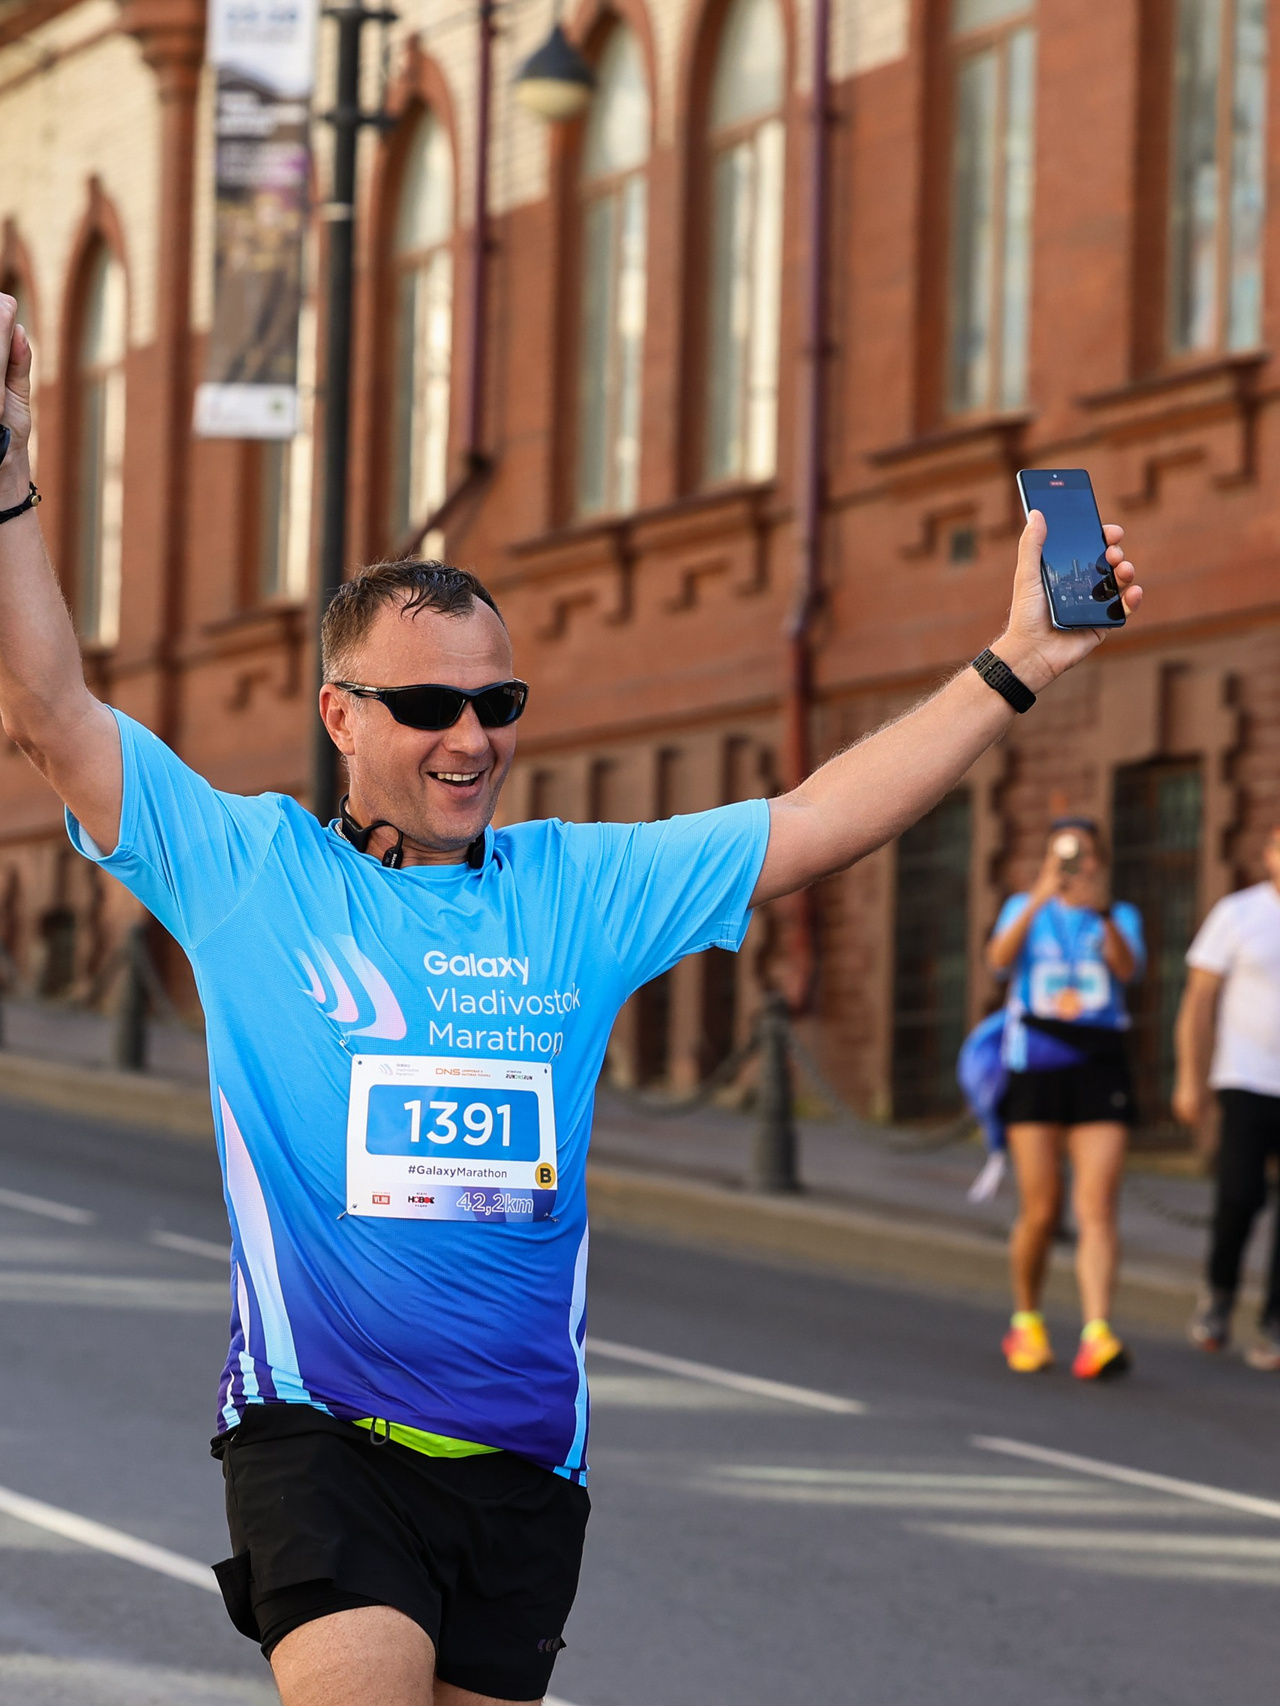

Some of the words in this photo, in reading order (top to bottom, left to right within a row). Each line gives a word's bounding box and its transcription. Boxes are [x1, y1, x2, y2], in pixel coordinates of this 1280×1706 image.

[423, 950, 529, 985] Galaxy
[426, 983, 581, 1015] Vladivostok
[428, 1020, 564, 1053] Marathon
[435, 1067, 460, 1076] DNS
[403, 1100, 511, 1147] 1391
[408, 1165, 508, 1179] #GalaxyMarathon
[540, 1167, 552, 1184] B
[456, 1192, 534, 1216] 42,2km
